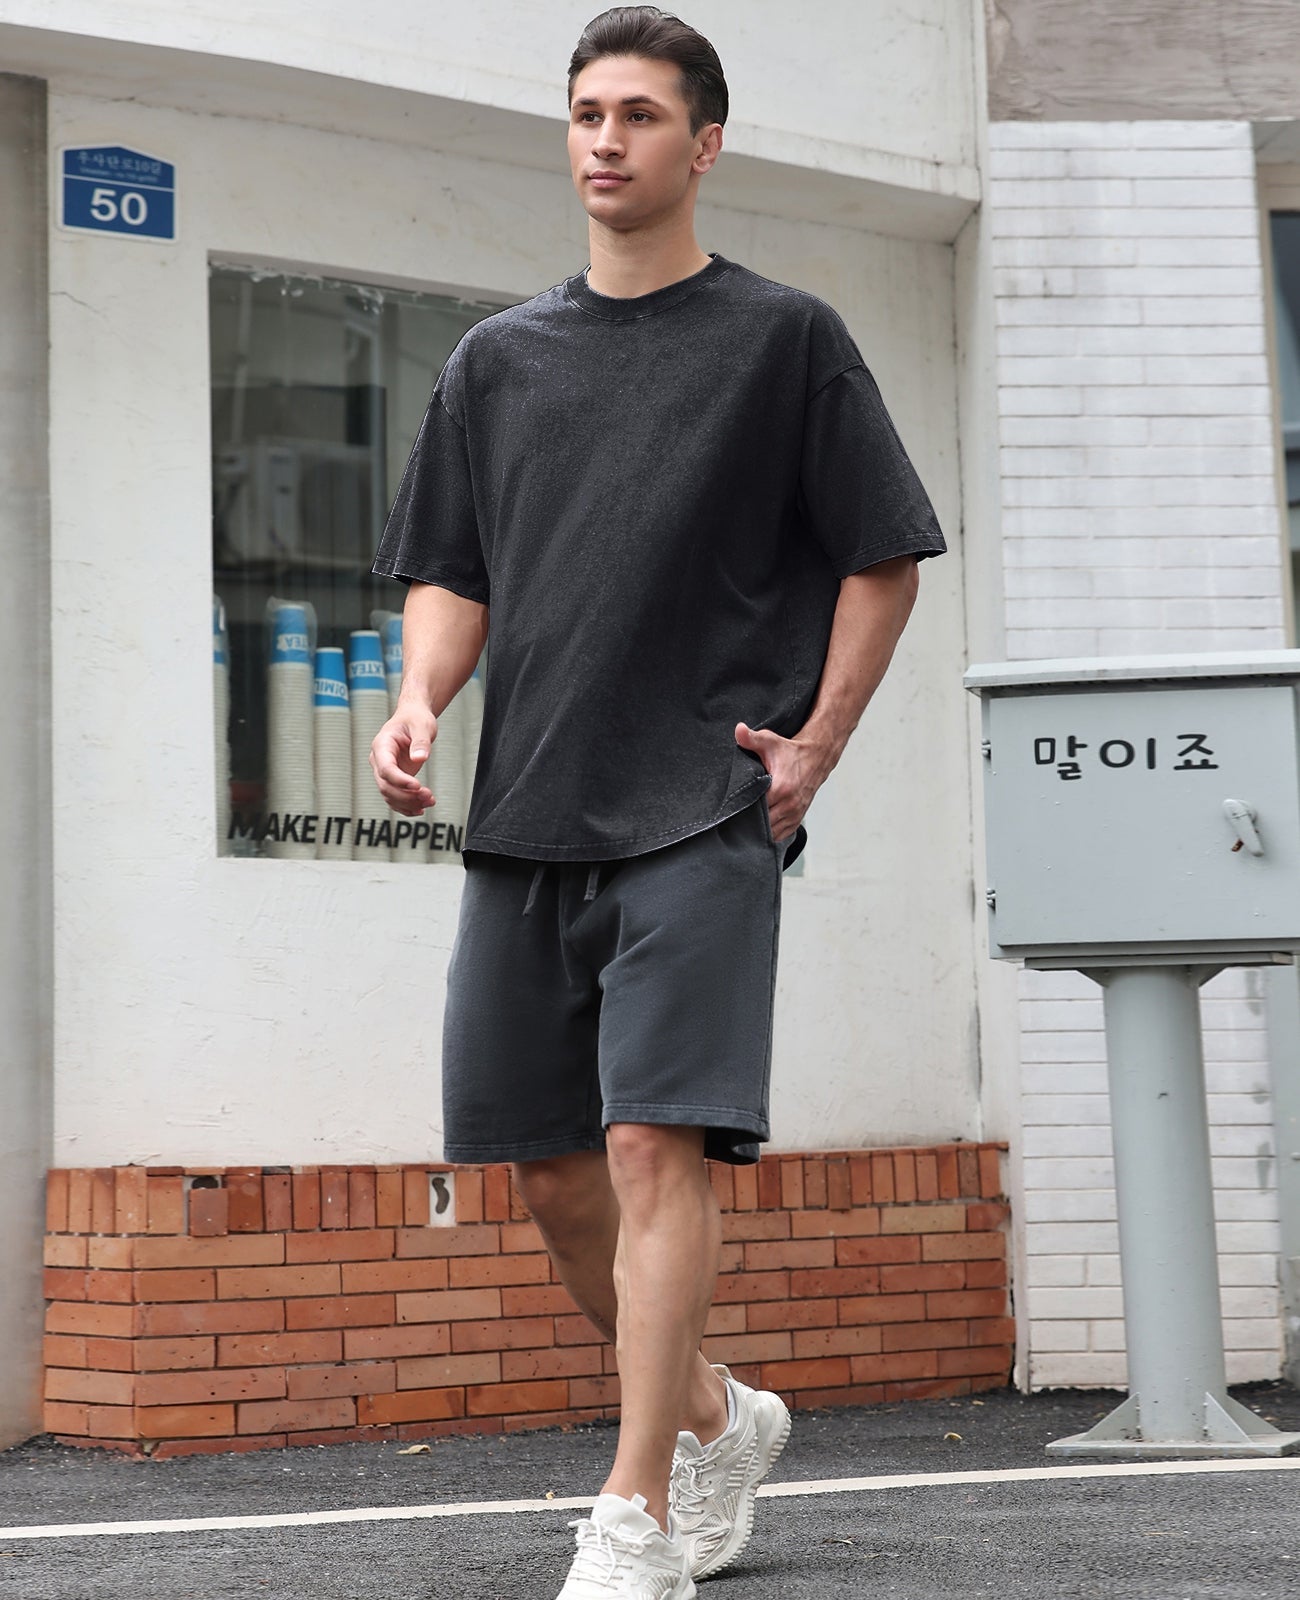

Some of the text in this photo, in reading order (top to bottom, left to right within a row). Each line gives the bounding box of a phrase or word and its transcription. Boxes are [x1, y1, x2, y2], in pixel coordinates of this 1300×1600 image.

[90, 188, 148, 226] 50
[1034, 734, 1219, 781] 말이죠
[228, 812, 463, 854] MAKE IT HAPPEN
